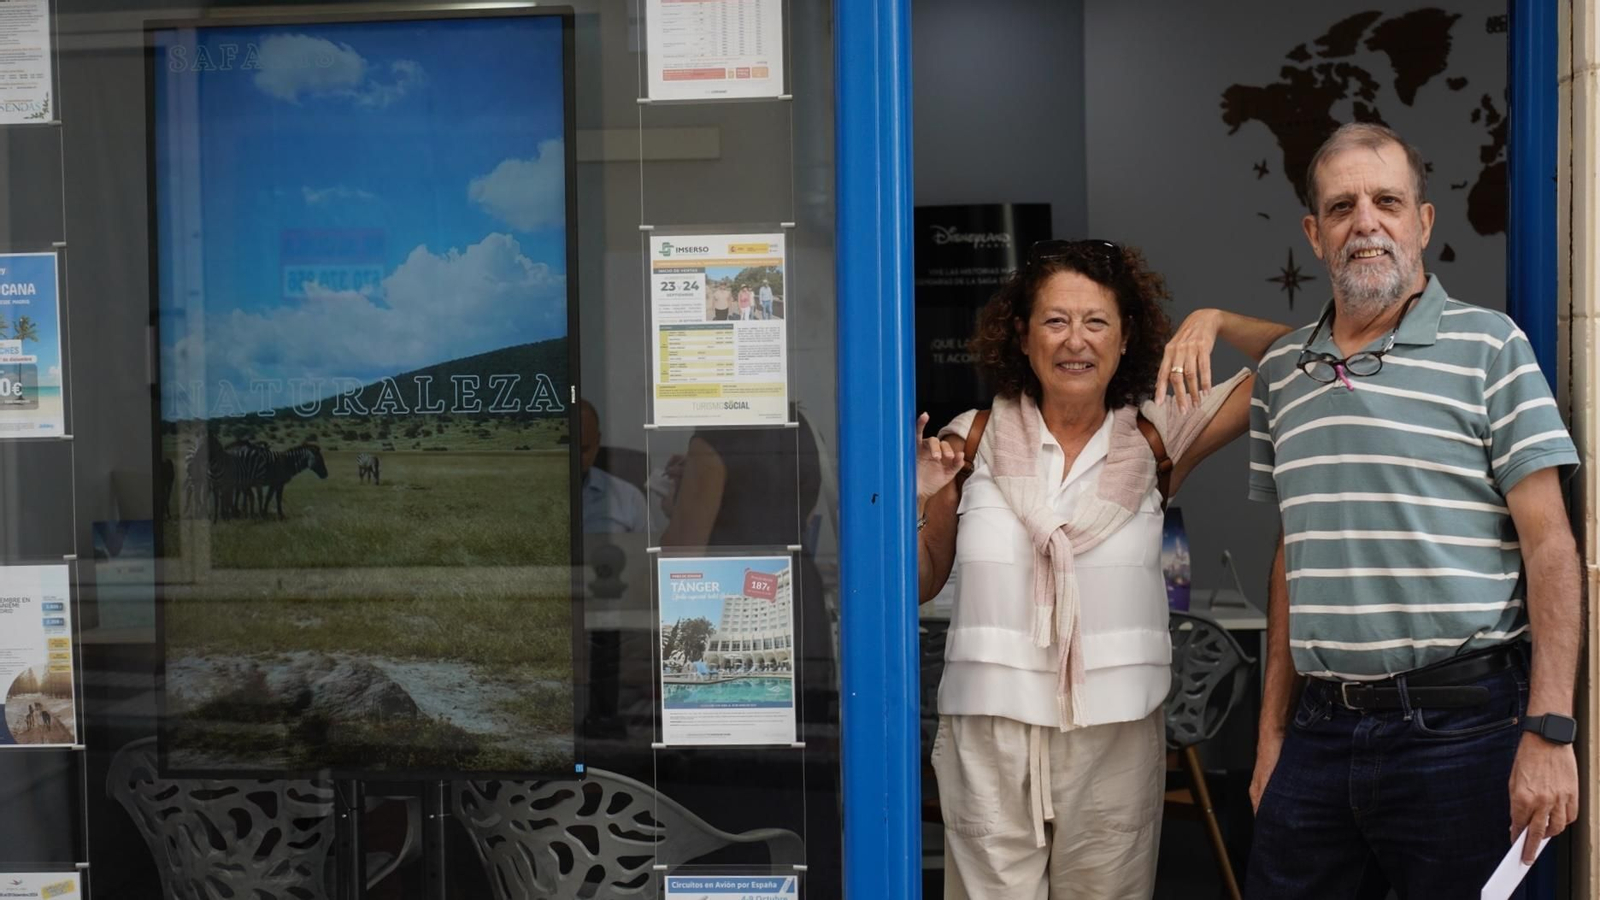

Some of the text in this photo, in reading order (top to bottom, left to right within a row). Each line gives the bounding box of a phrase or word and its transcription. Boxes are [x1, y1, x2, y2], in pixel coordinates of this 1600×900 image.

[676, 246, 709, 254] IMSERSO
[661, 281, 676, 291] 23
[683, 281, 700, 291] 24
[167, 373, 565, 421] NATURALEZA
[670, 580, 720, 593] TÁNGER
[715, 880, 736, 888] Avión
[737, 882, 750, 890] por
[751, 881, 777, 890] España
